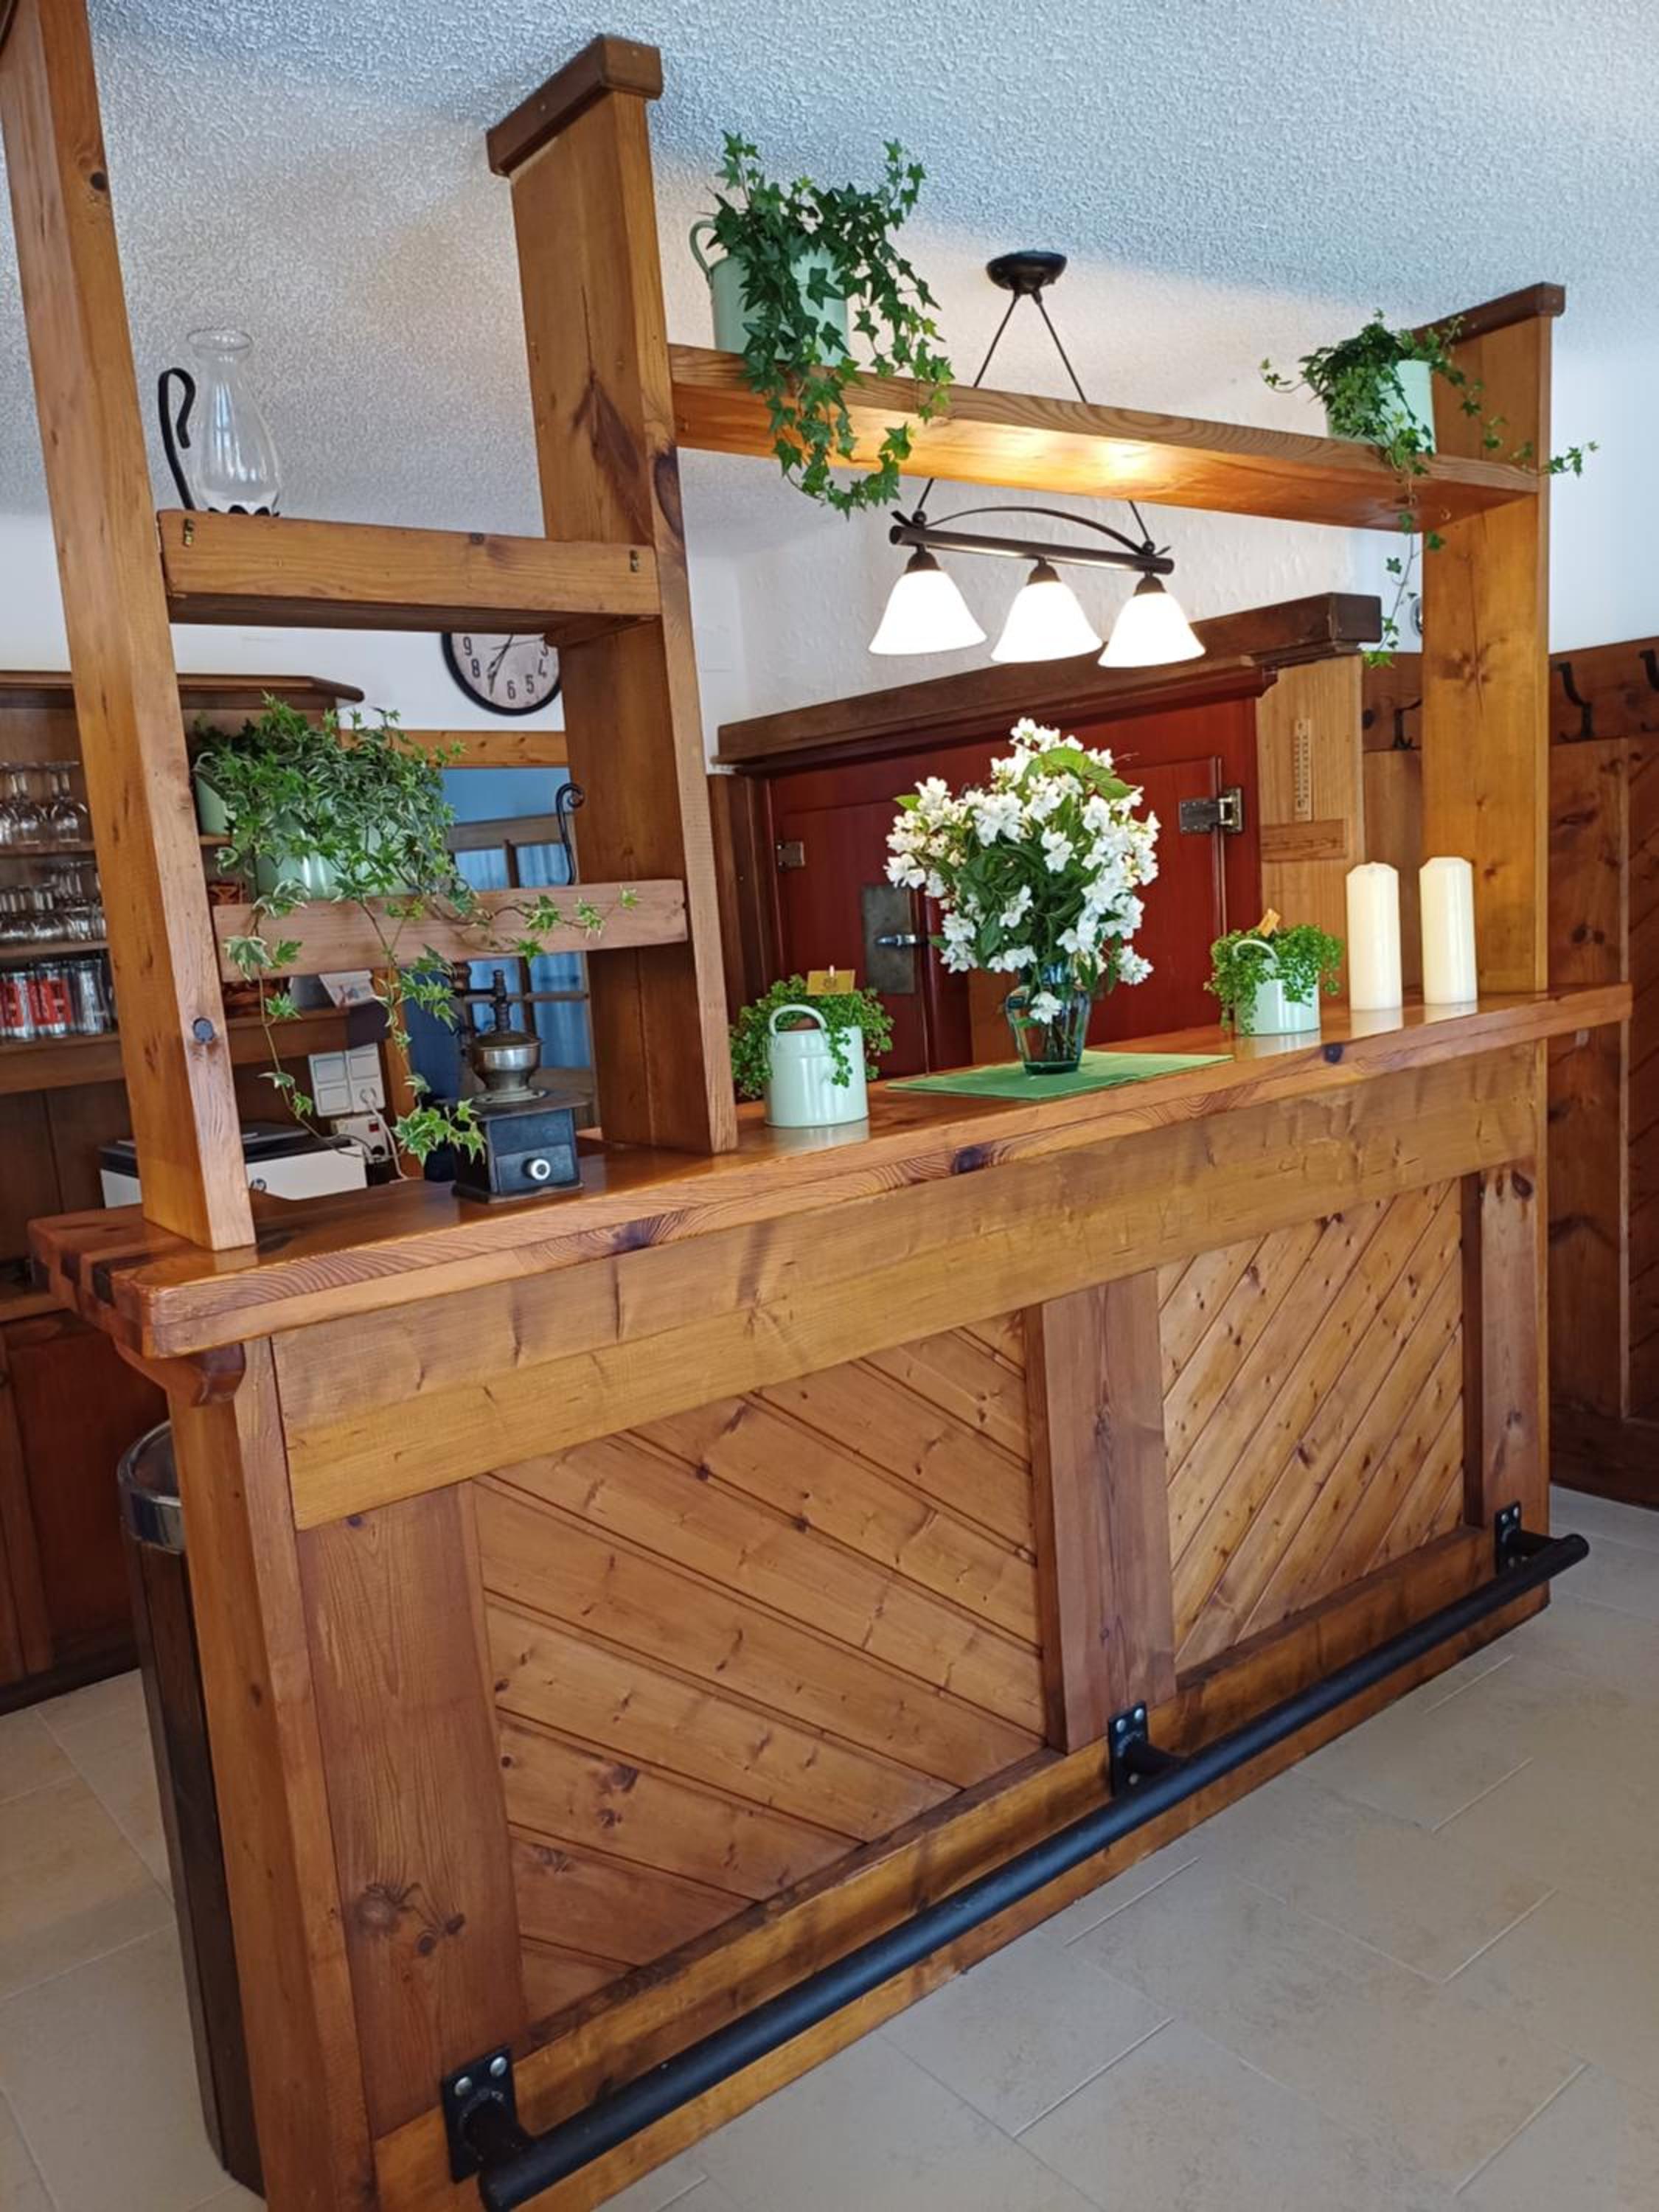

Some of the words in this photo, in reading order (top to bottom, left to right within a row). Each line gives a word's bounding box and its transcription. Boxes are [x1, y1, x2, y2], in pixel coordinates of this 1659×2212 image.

[463, 636, 472, 655] 9
[471, 658, 481, 678] 8
[538, 658, 547, 678] 4
[507, 680, 516, 700] 6
[525, 674, 535, 694] 5
